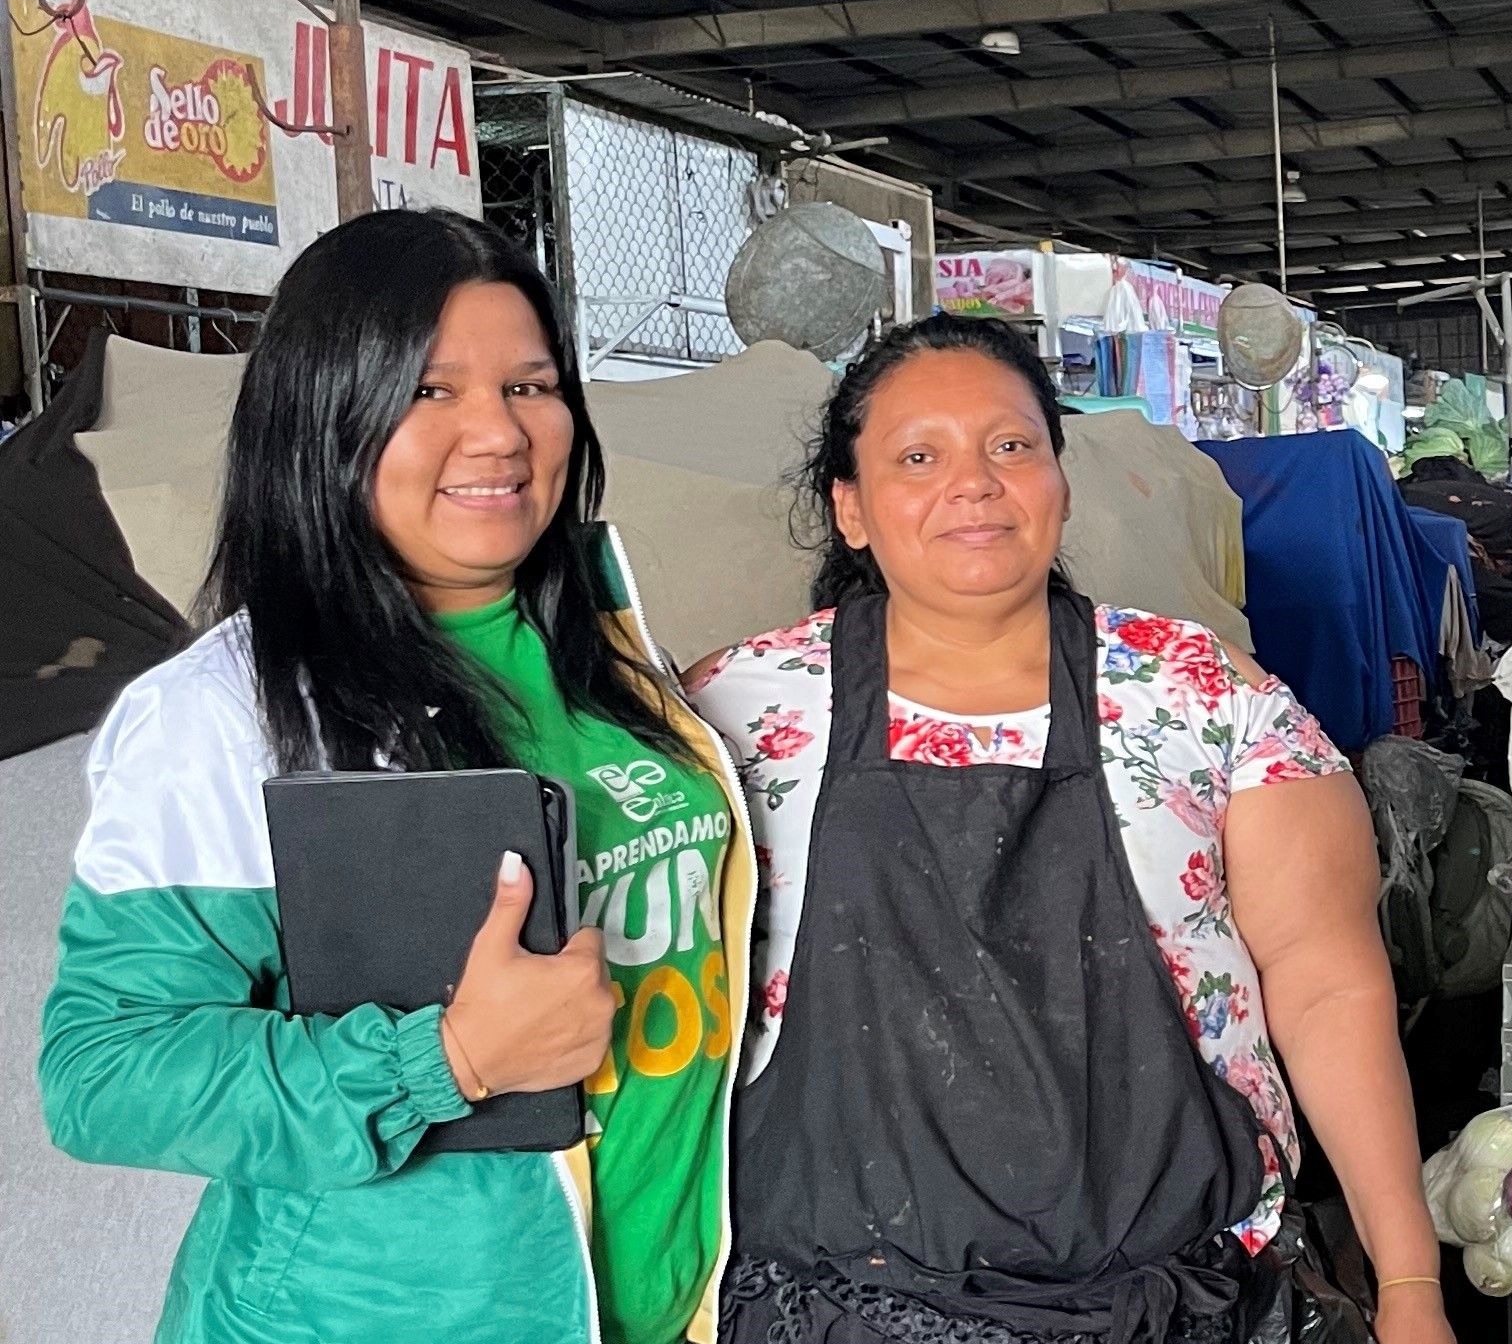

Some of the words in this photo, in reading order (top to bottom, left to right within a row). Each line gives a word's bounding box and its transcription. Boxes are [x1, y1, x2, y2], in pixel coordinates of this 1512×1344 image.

[150, 67, 220, 125] Sello
[145, 110, 180, 150] de
[181, 121, 227, 156] oro
[131, 193, 144, 212] El
[148, 198, 176, 219] pollo
[179, 202, 195, 222] de
[198, 211, 237, 228] nuestro
[241, 215, 274, 234] pueblo
[576, 810, 731, 885] APRENDAMO
